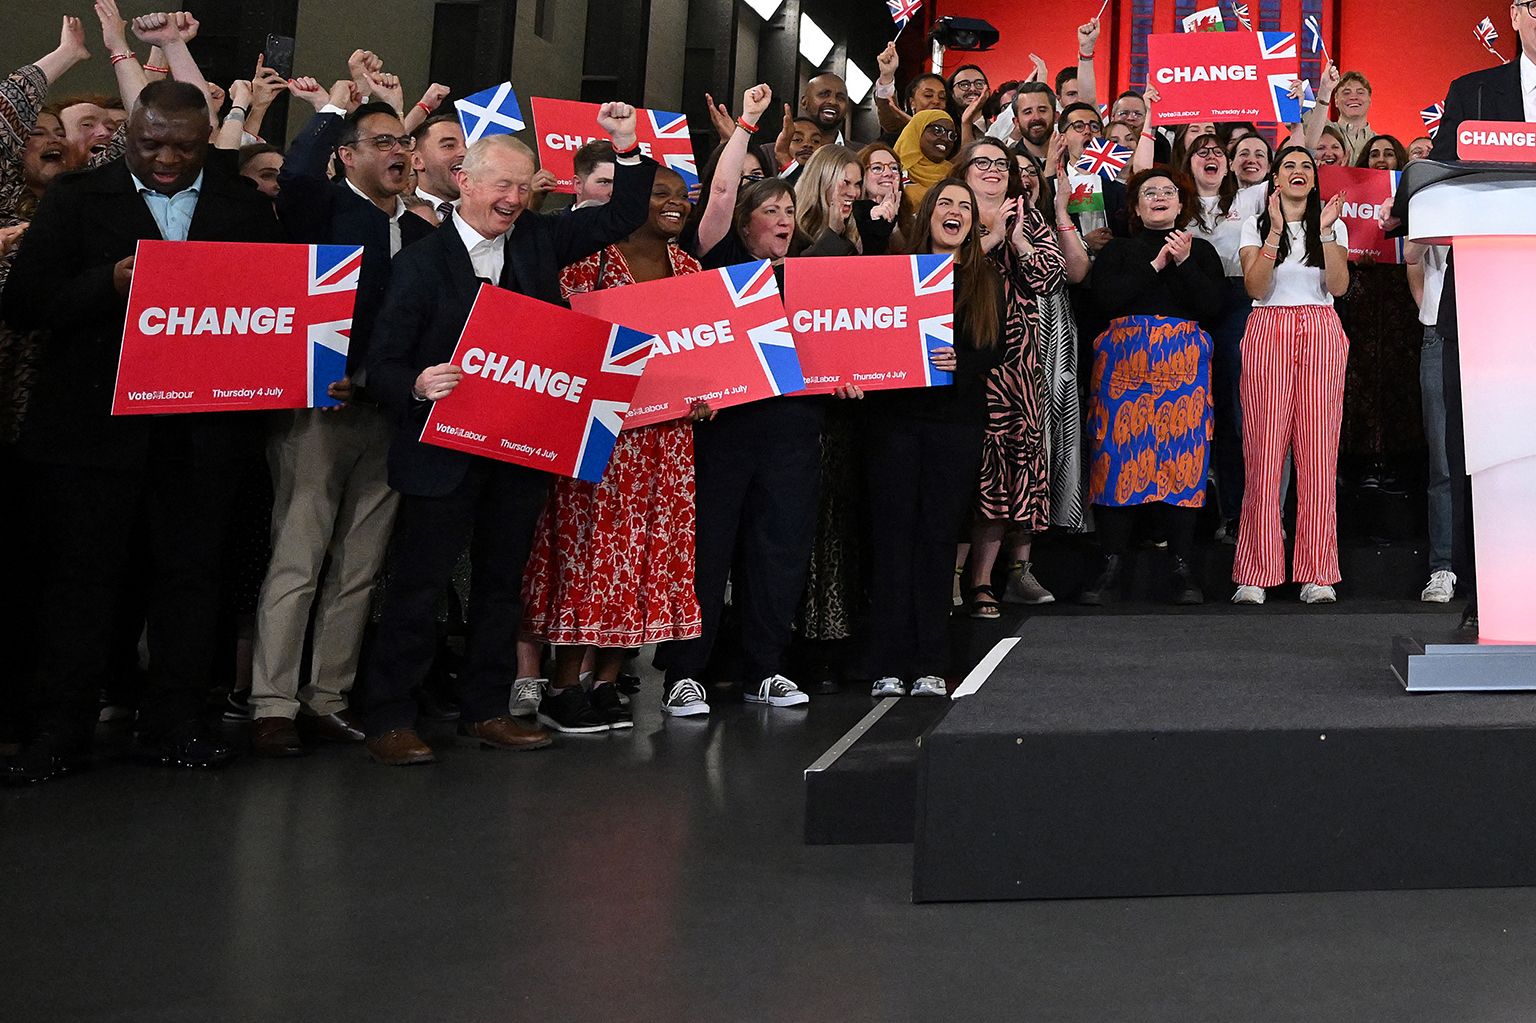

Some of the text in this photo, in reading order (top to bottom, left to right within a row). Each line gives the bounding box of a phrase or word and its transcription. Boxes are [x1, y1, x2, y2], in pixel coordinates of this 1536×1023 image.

[1156, 65, 1258, 84] CHANGE
[1246, 108, 1259, 116] July
[545, 133, 652, 158] CHE
[1459, 130, 1536, 146] CHANGE
[1341, 201, 1381, 220] NGE
[138, 307, 296, 336] CHANGE
[792, 306, 908, 333] CHANGE
[648, 319, 735, 359] ANGE
[461, 347, 588, 404] CHANGE
[816, 375, 841, 384] Labour
[852, 370, 907, 381] Thursday 4 July
[128, 390, 194, 401] Vote Labour
[212, 387, 284, 399] Thursday 4 July
[731, 384, 748, 395] July
[640, 402, 669, 415] Labour
[436, 422, 488, 442] Vote Labour
[500, 438, 559, 462] Thursday 4 July
